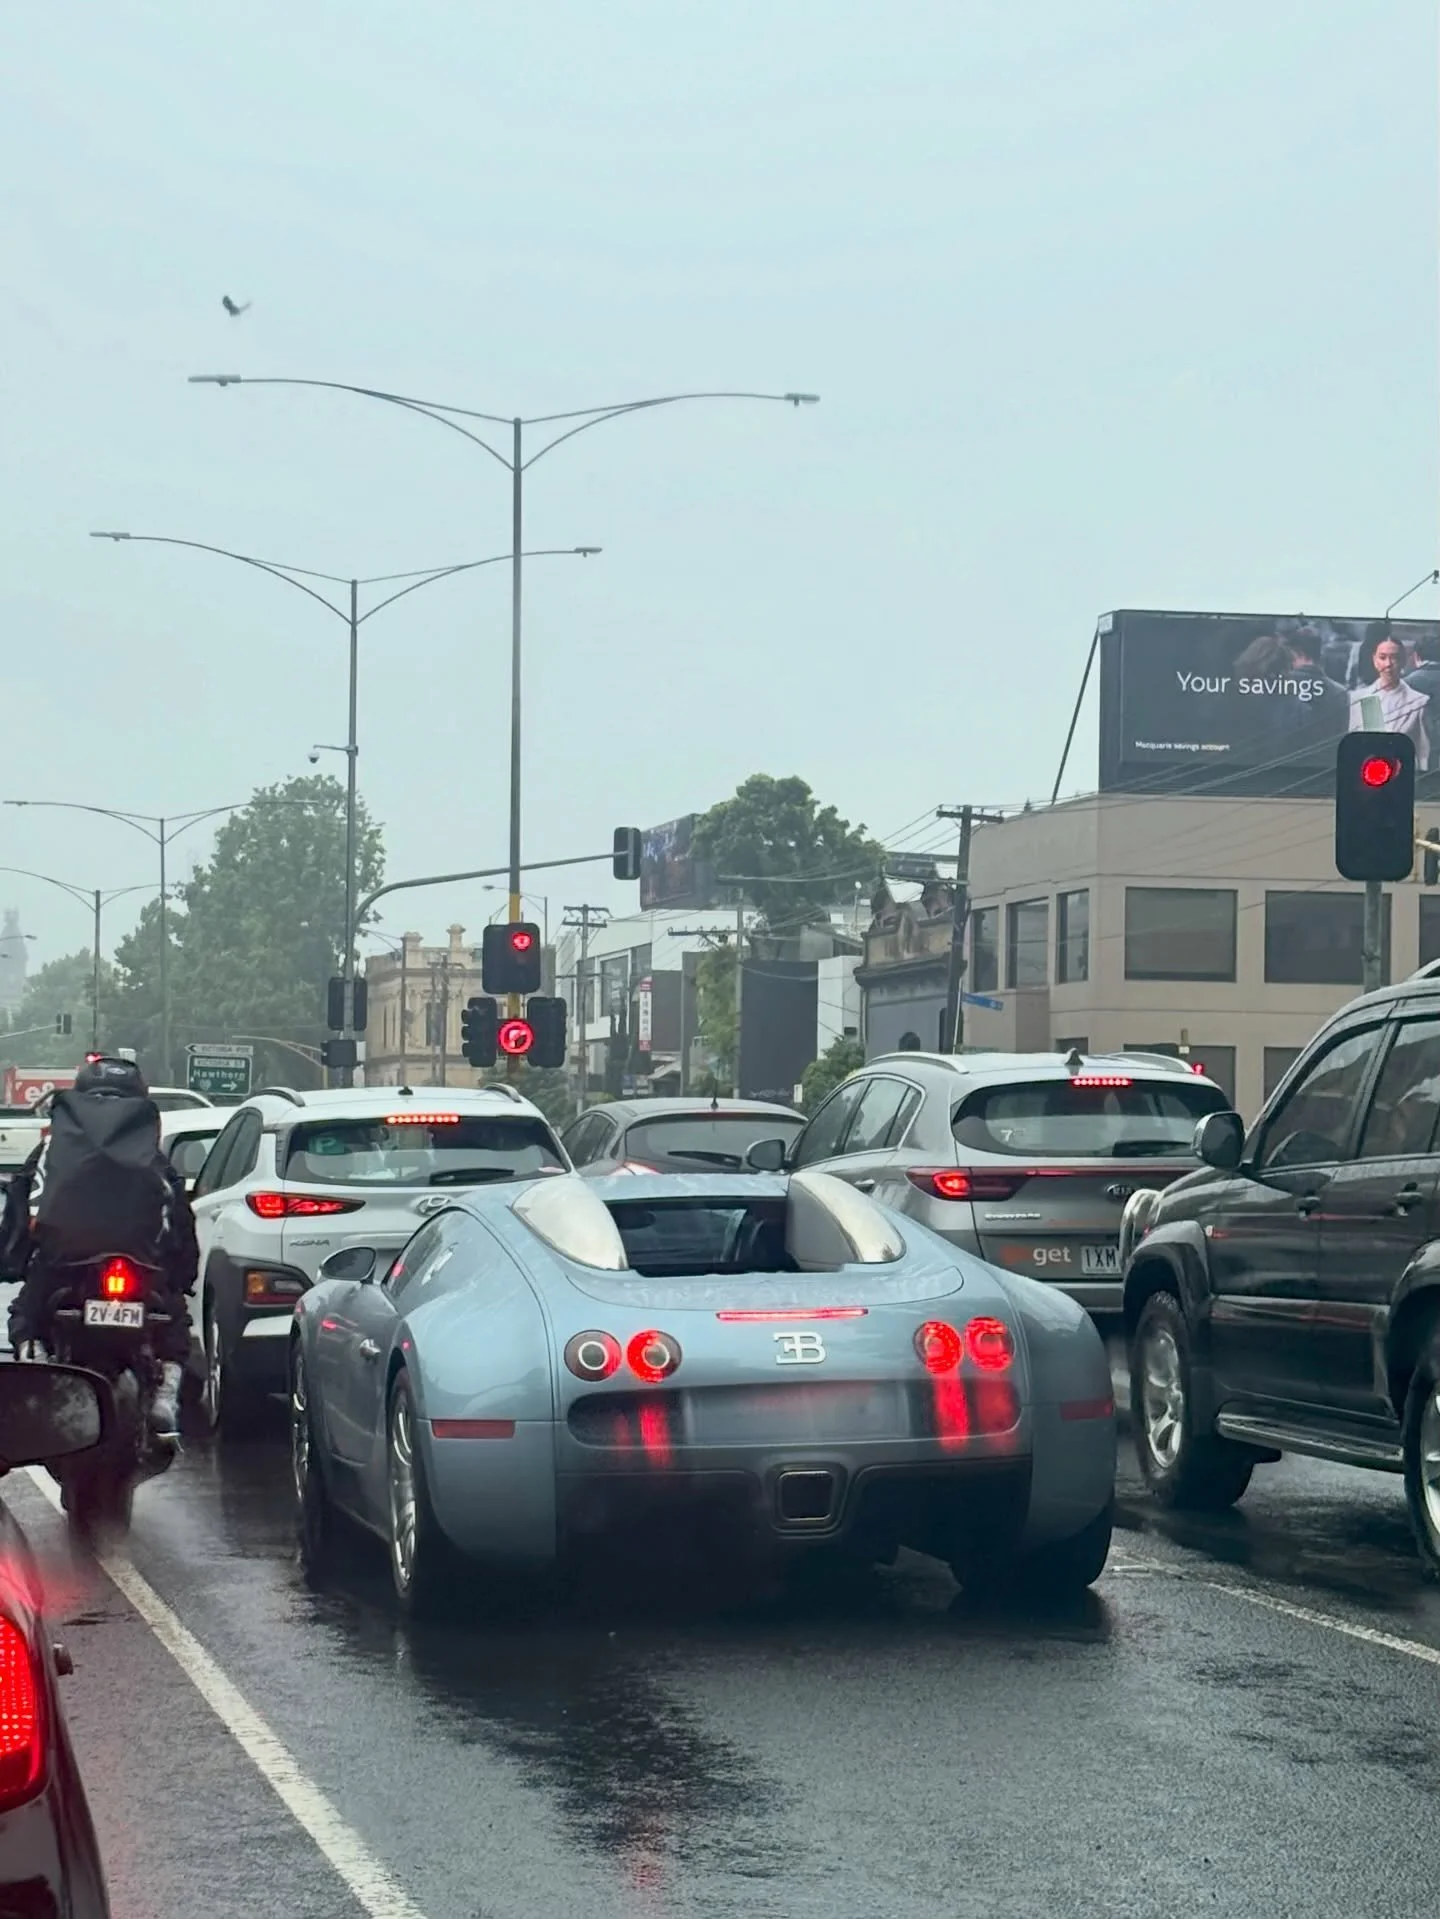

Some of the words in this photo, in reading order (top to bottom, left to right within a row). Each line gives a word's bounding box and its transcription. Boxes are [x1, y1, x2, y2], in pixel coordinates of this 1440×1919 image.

[1176, 671, 1231, 693] Your
[1238, 674, 1325, 702] savings
[193, 1069, 246, 1081] Hawthorn
[1033, 1246, 1072, 1267] get
